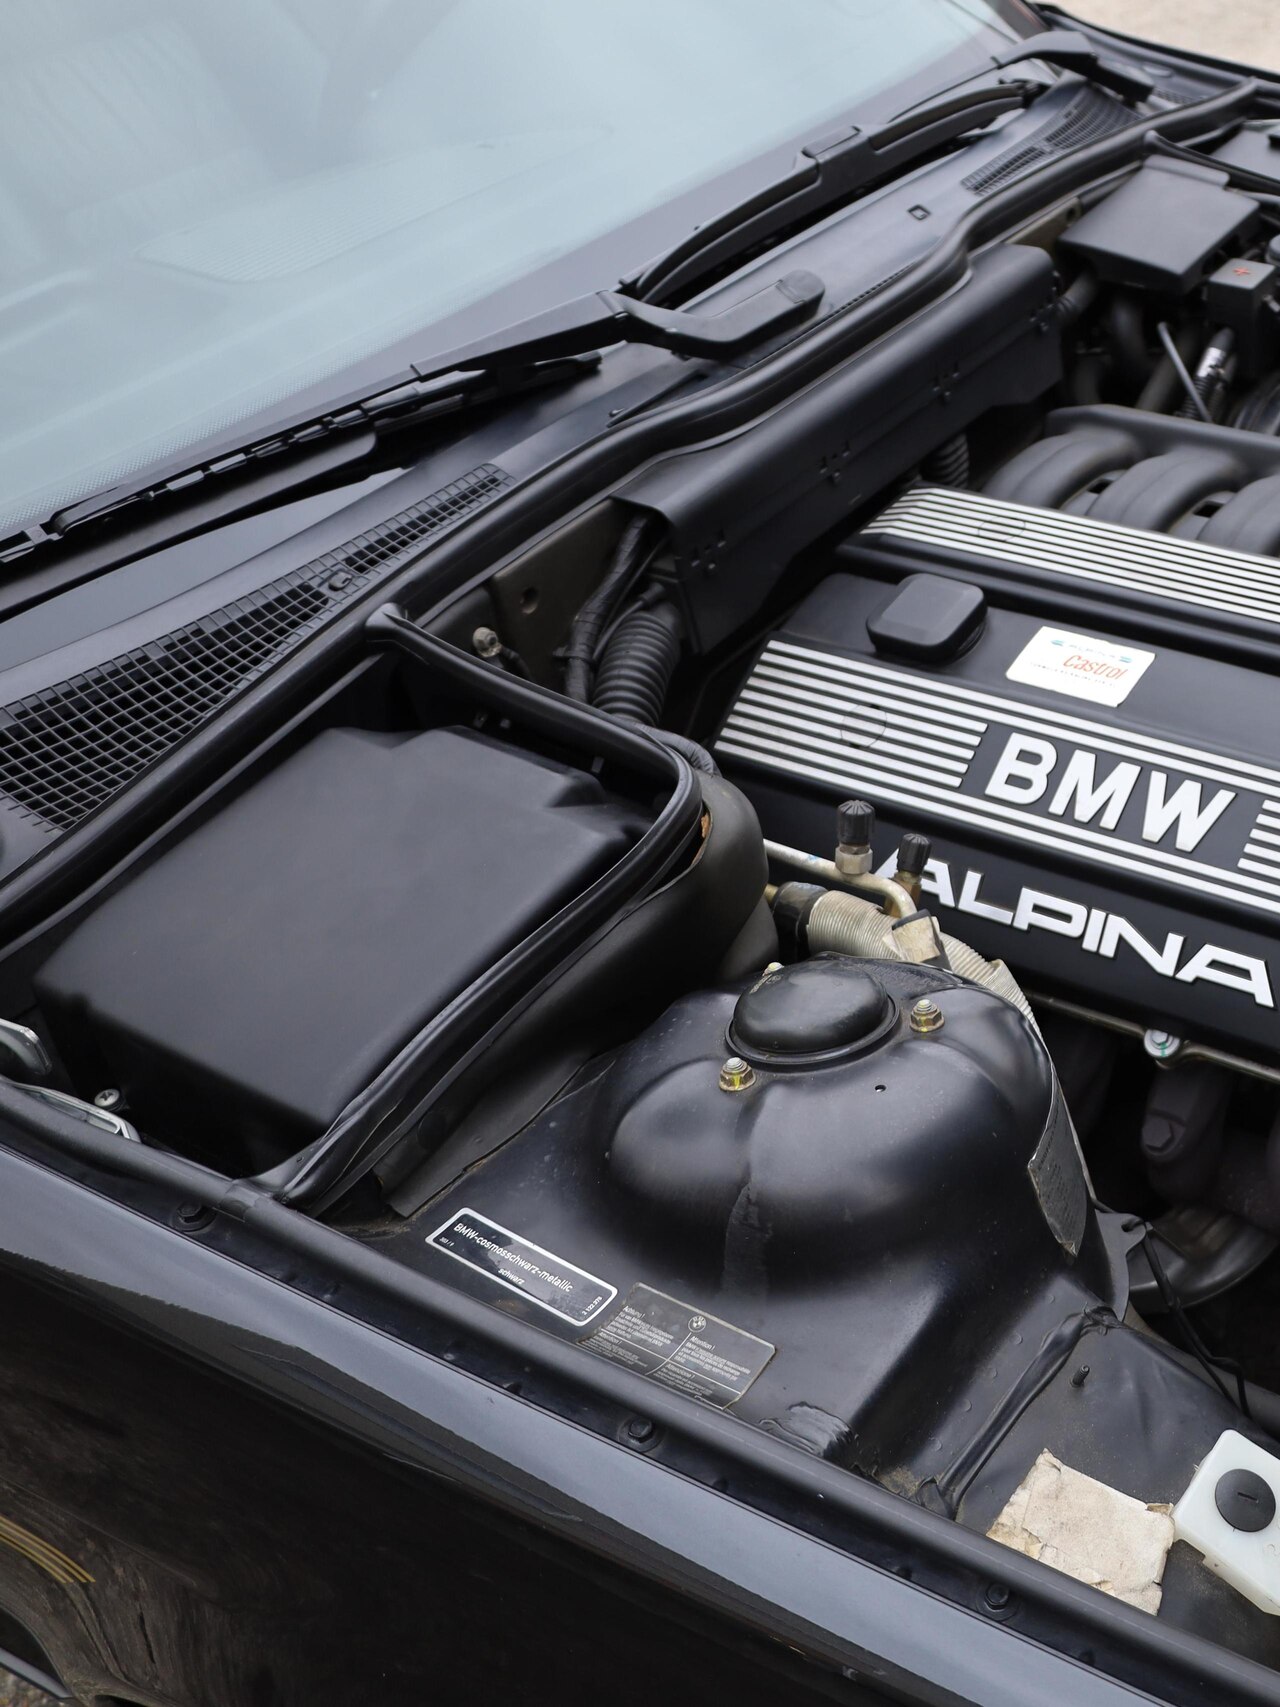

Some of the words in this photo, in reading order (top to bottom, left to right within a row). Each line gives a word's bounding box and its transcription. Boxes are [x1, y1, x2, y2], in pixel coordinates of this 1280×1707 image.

[1063, 655, 1129, 680] Castrol
[985, 731, 1237, 853] BMW
[874, 848, 1275, 1008] ALPINA
[453, 1222, 574, 1293] BMW-cosmosschwarz-metallic
[497, 1267, 526, 1285] schwarz
